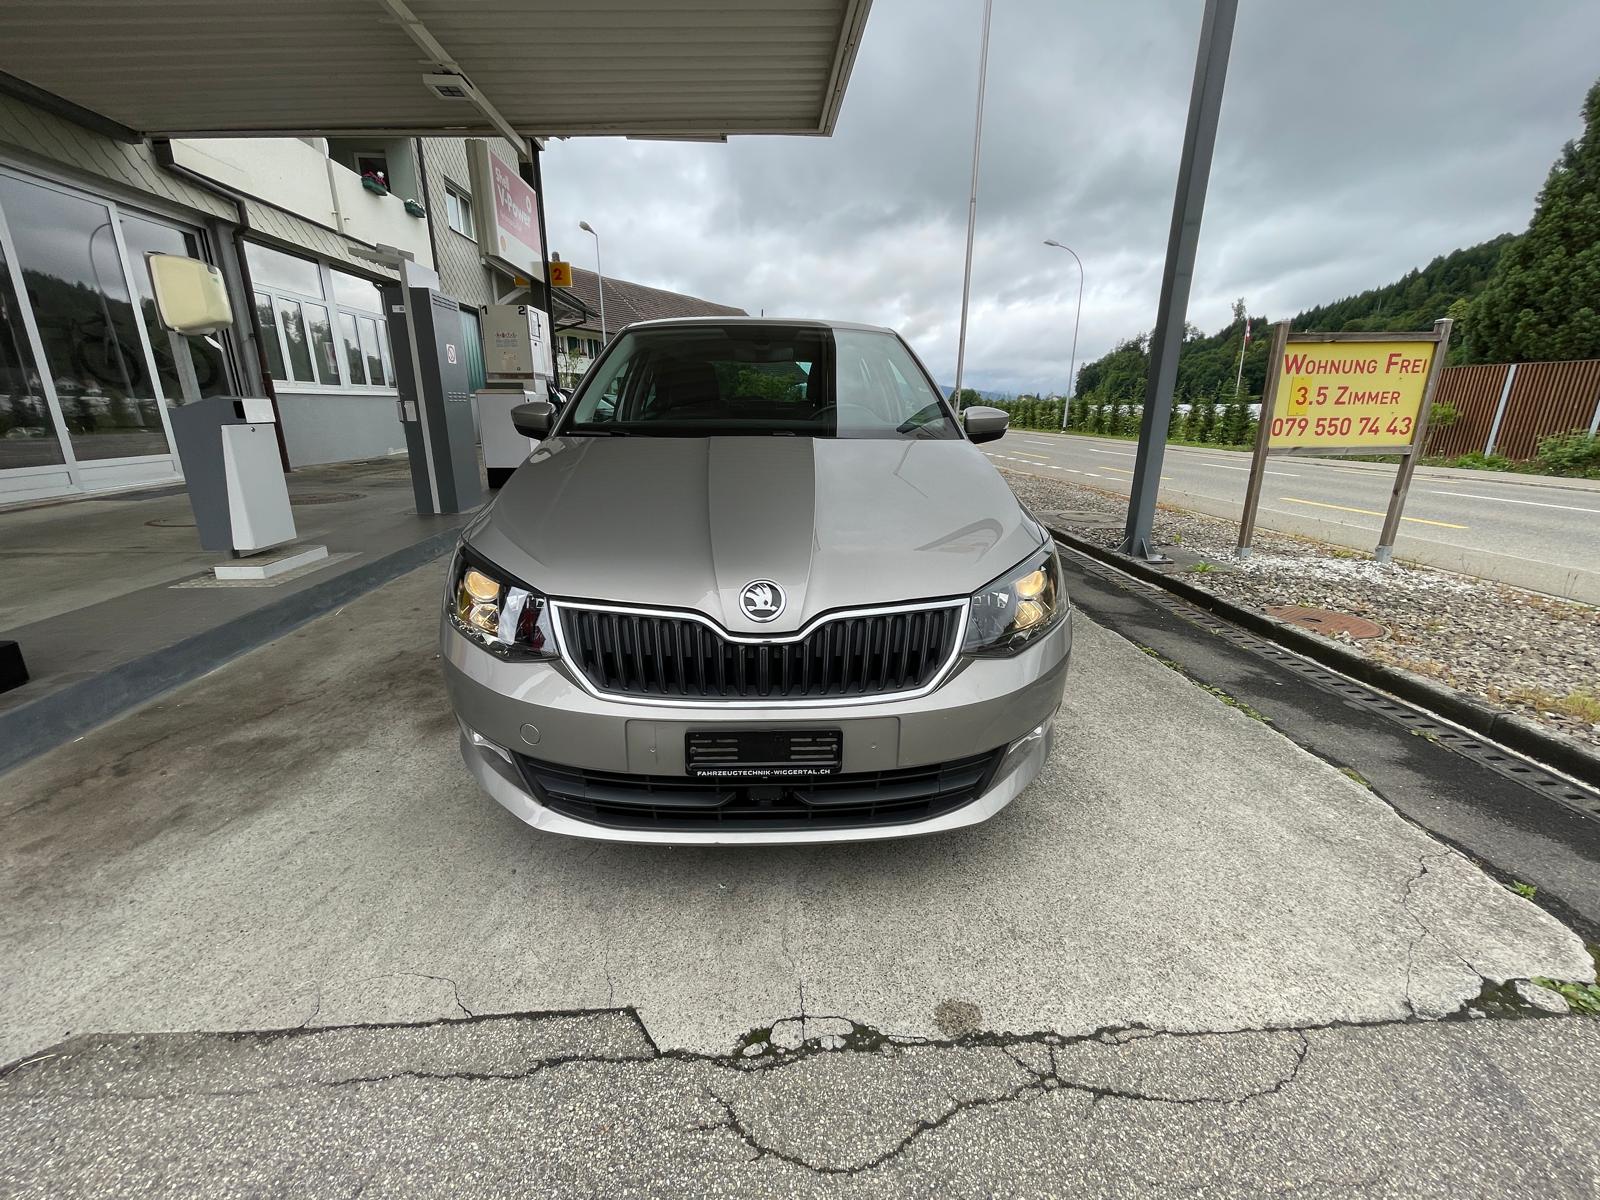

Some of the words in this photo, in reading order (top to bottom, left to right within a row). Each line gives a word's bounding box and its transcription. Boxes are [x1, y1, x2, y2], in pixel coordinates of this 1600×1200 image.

[495, 167, 510, 191] Shell
[497, 183, 531, 227] V-Power
[553, 267, 563, 281] 2
[481, 305, 488, 315] 1
[518, 305, 526, 315] 2
[1284, 353, 1377, 375] WOHNUNG
[1385, 353, 1427, 374] FREI
[1295, 386, 1329, 406] 3.5
[1334, 386, 1401, 406] ZIMMER
[1272, 418, 1309, 436] 079
[1314, 417, 1352, 436] 550
[1358, 417, 1380, 436] 74
[1386, 416, 1412, 435] 43
[696, 769, 831, 777] FAHRZEUGTECHNIK-WIGGERTAL.CH
